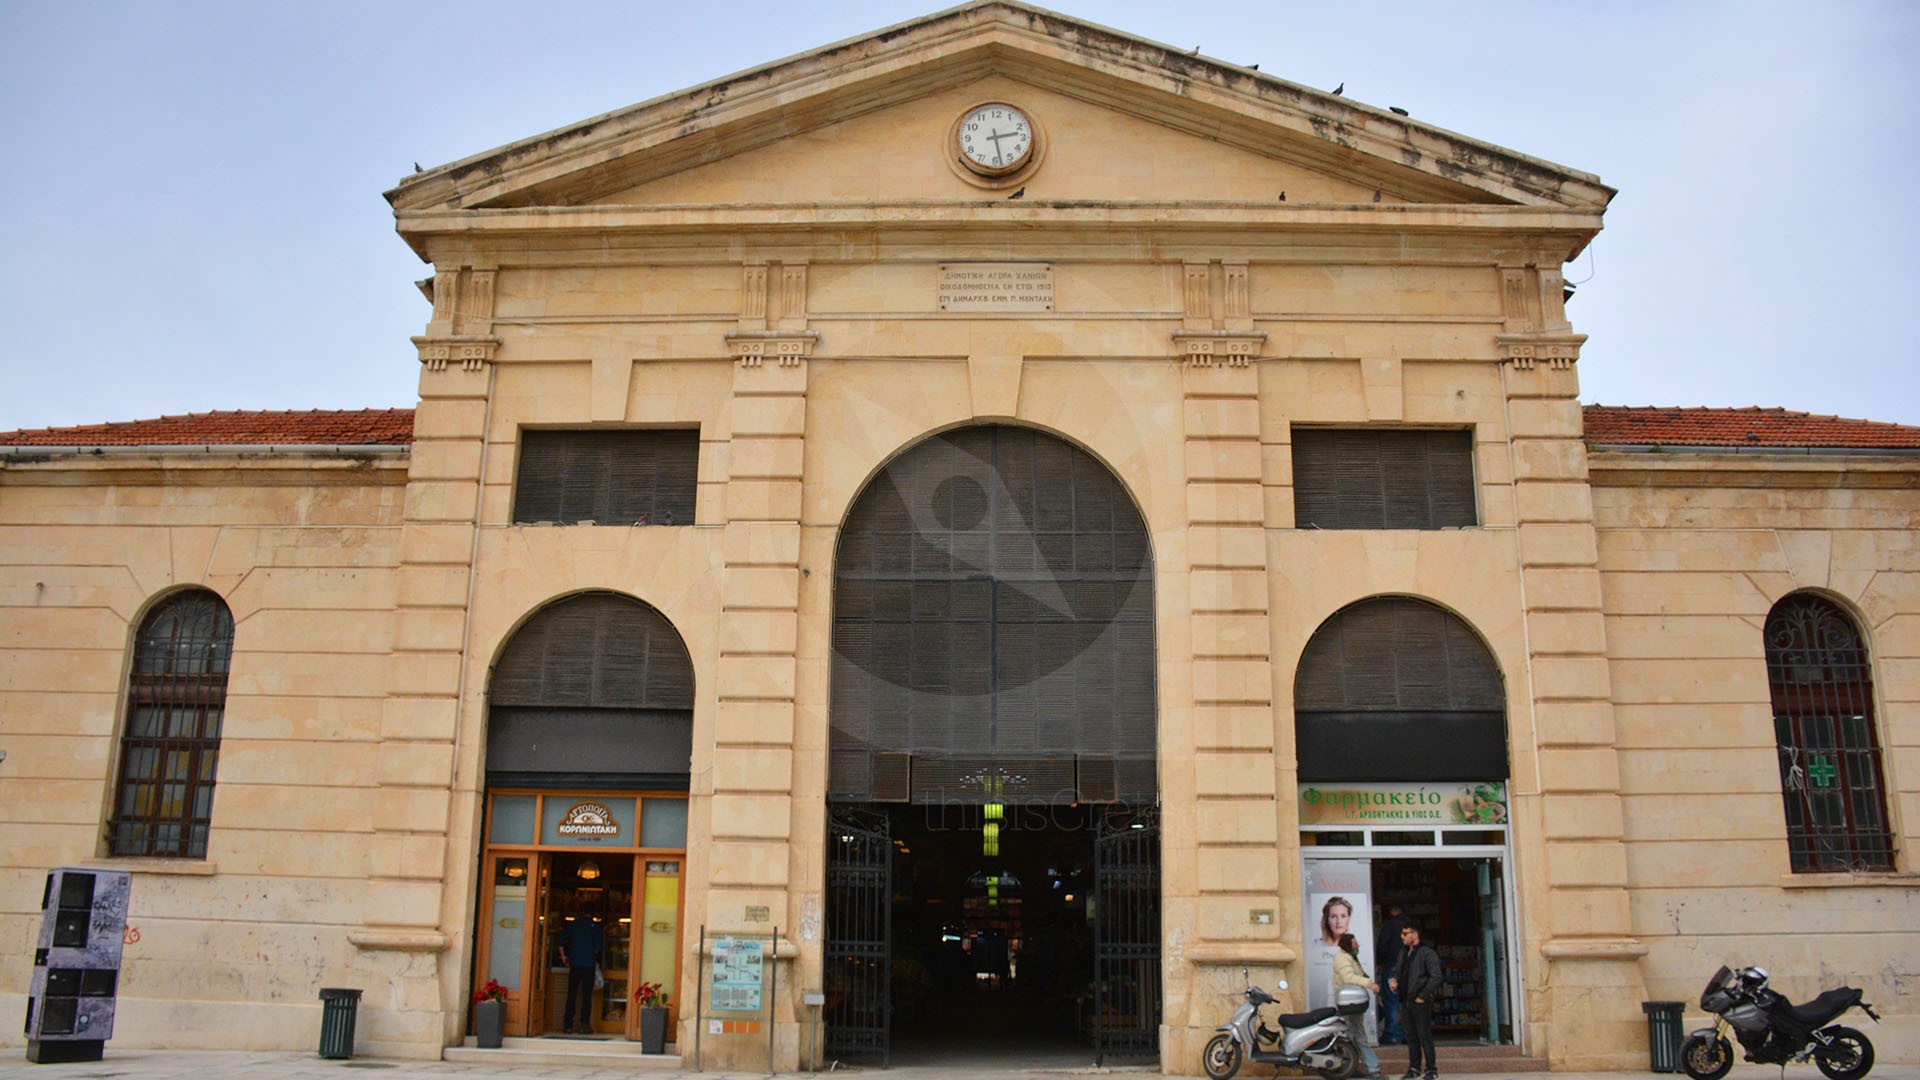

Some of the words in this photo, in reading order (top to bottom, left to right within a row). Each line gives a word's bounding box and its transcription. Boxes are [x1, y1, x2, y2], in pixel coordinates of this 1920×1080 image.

[967, 123, 978, 131] 10
[1020, 133, 1026, 141] 3
[1014, 144, 1021, 152] 4
[992, 156, 998, 164] 6
[1006, 153, 1013, 161] 5
[1303, 787, 1441, 809] Φαρμακείο
[560, 825, 617, 834] ΚΟΡΩΝΙΩΤΑΚΗ
